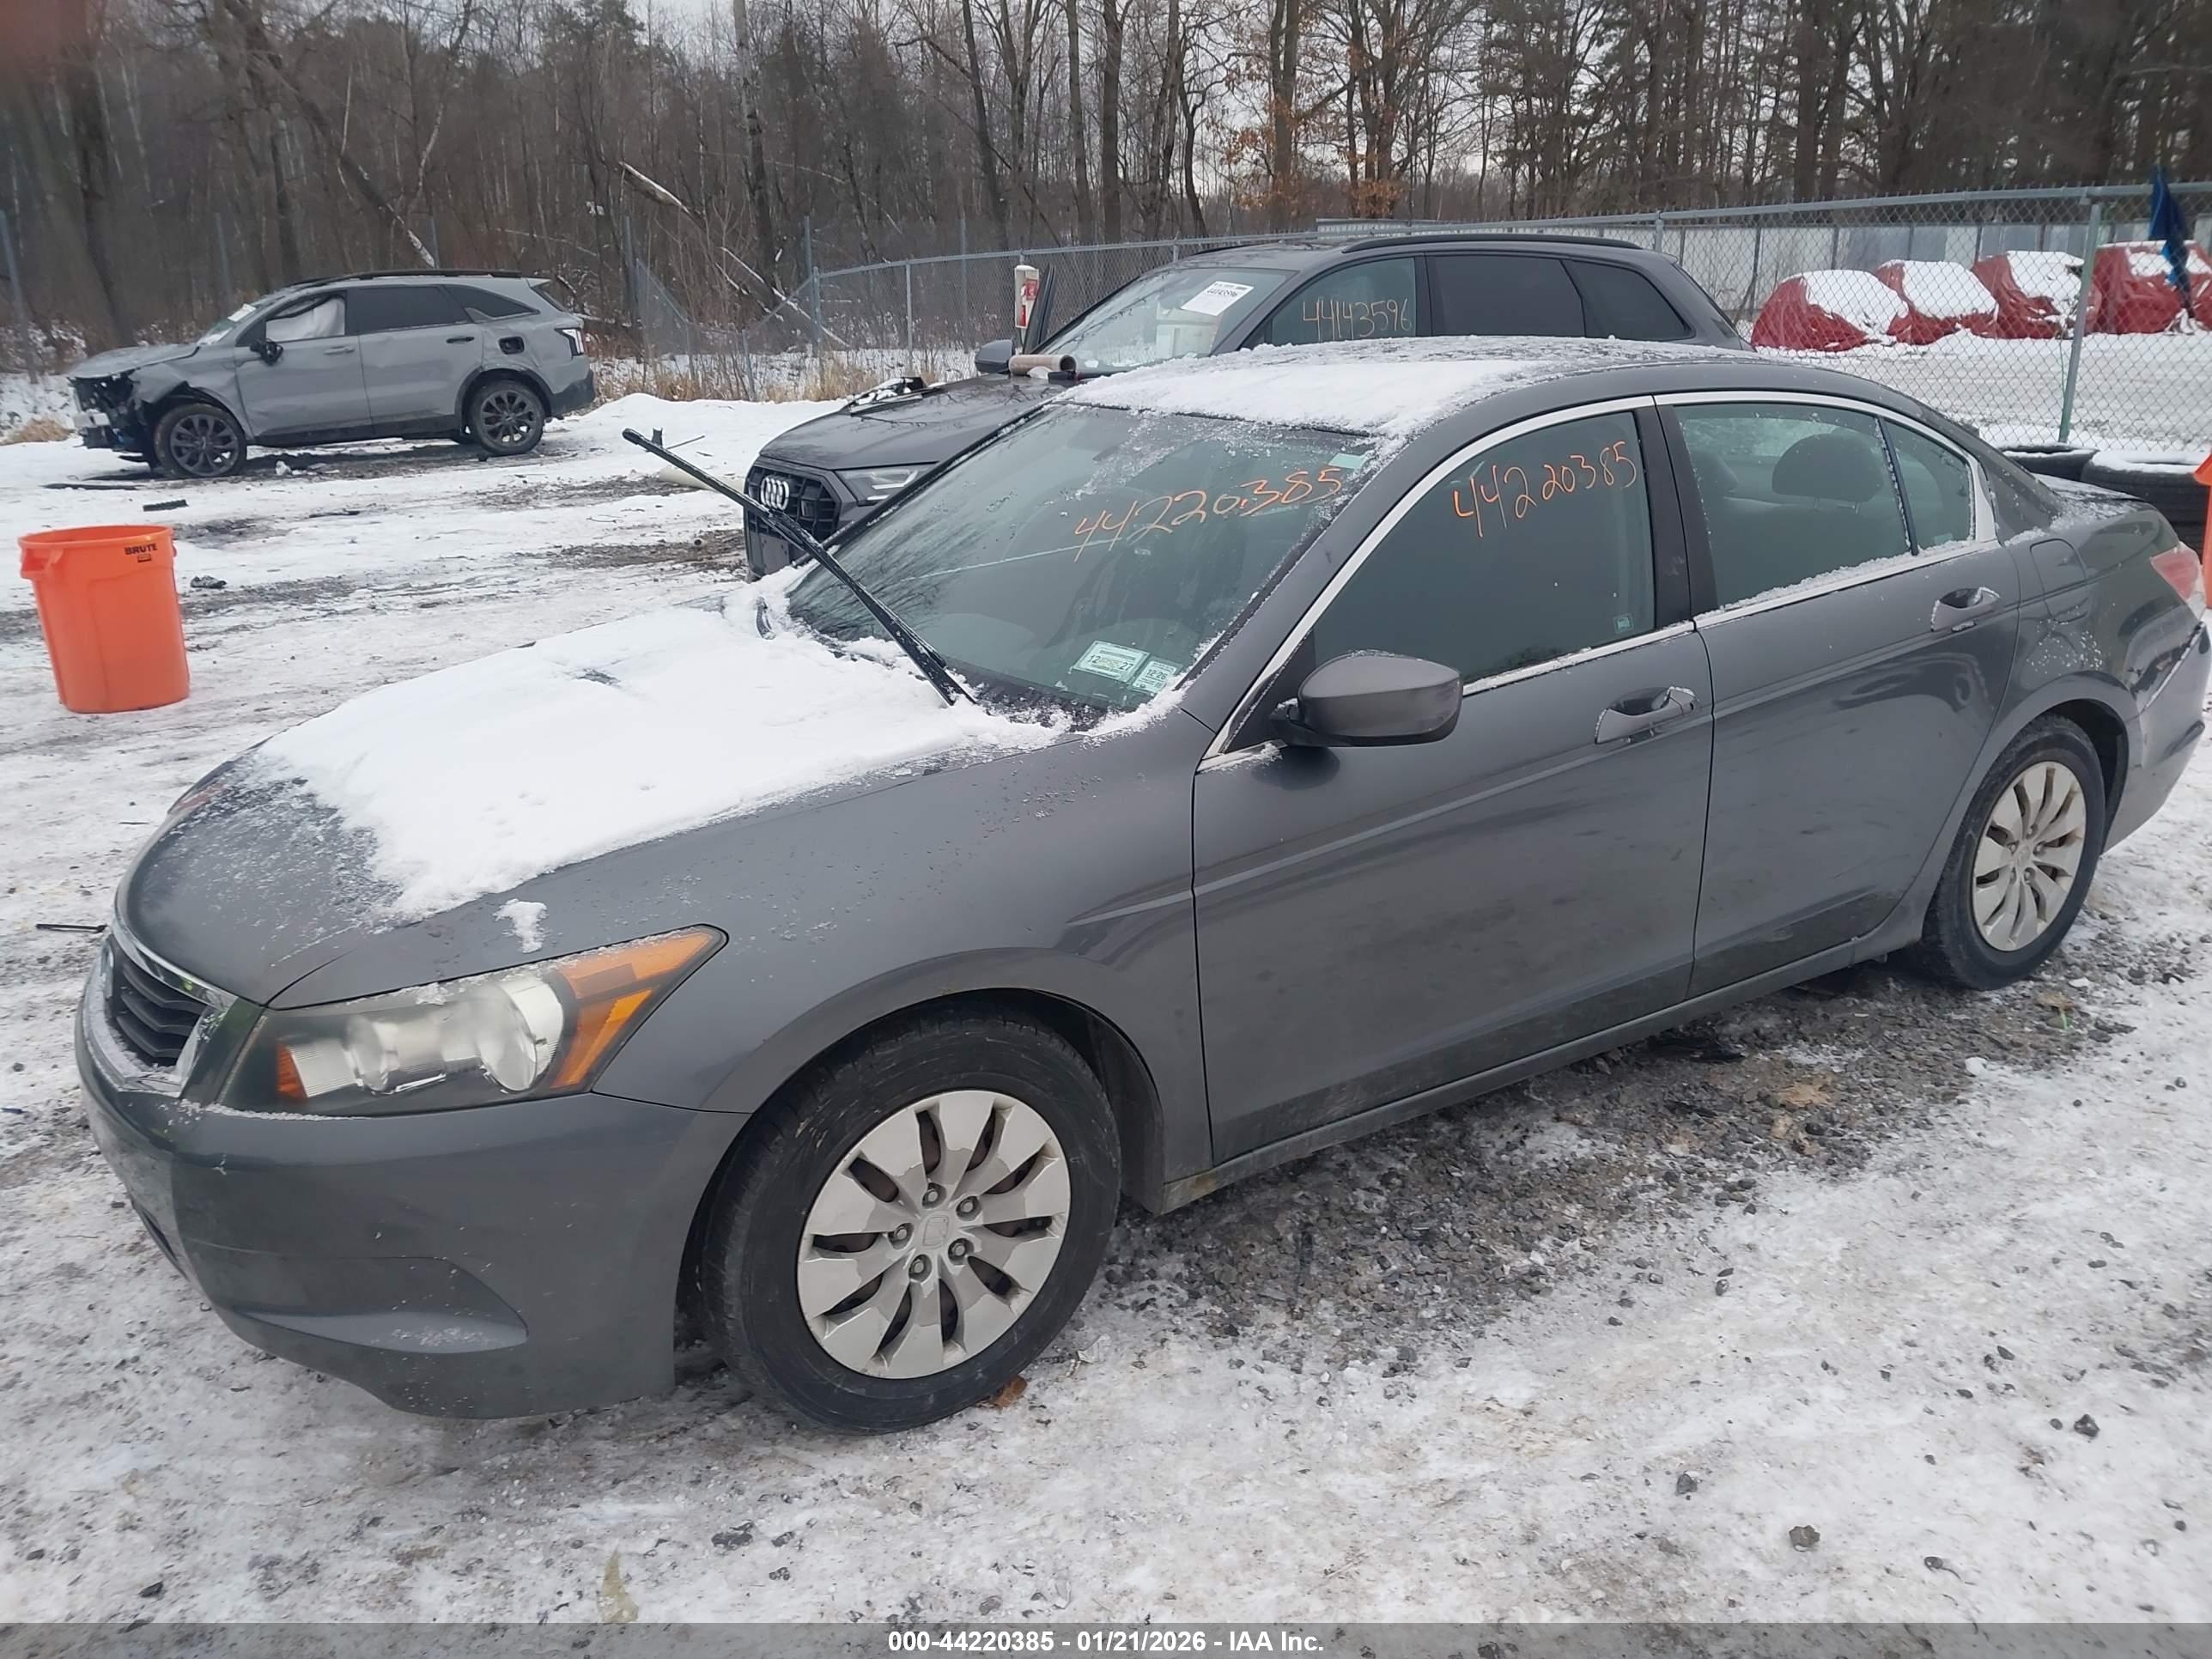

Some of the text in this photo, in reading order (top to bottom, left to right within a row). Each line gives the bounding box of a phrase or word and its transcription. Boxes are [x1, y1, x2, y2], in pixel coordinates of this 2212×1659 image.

[1303, 297, 1412, 343] 44143596
[1452, 441, 1637, 538] 44220385
[1074, 468, 1342, 563] 44220385
[124, 543, 158, 556] BRUTE
[1087, 654, 1101, 664] 12
[1119, 661, 1134, 672] 27
